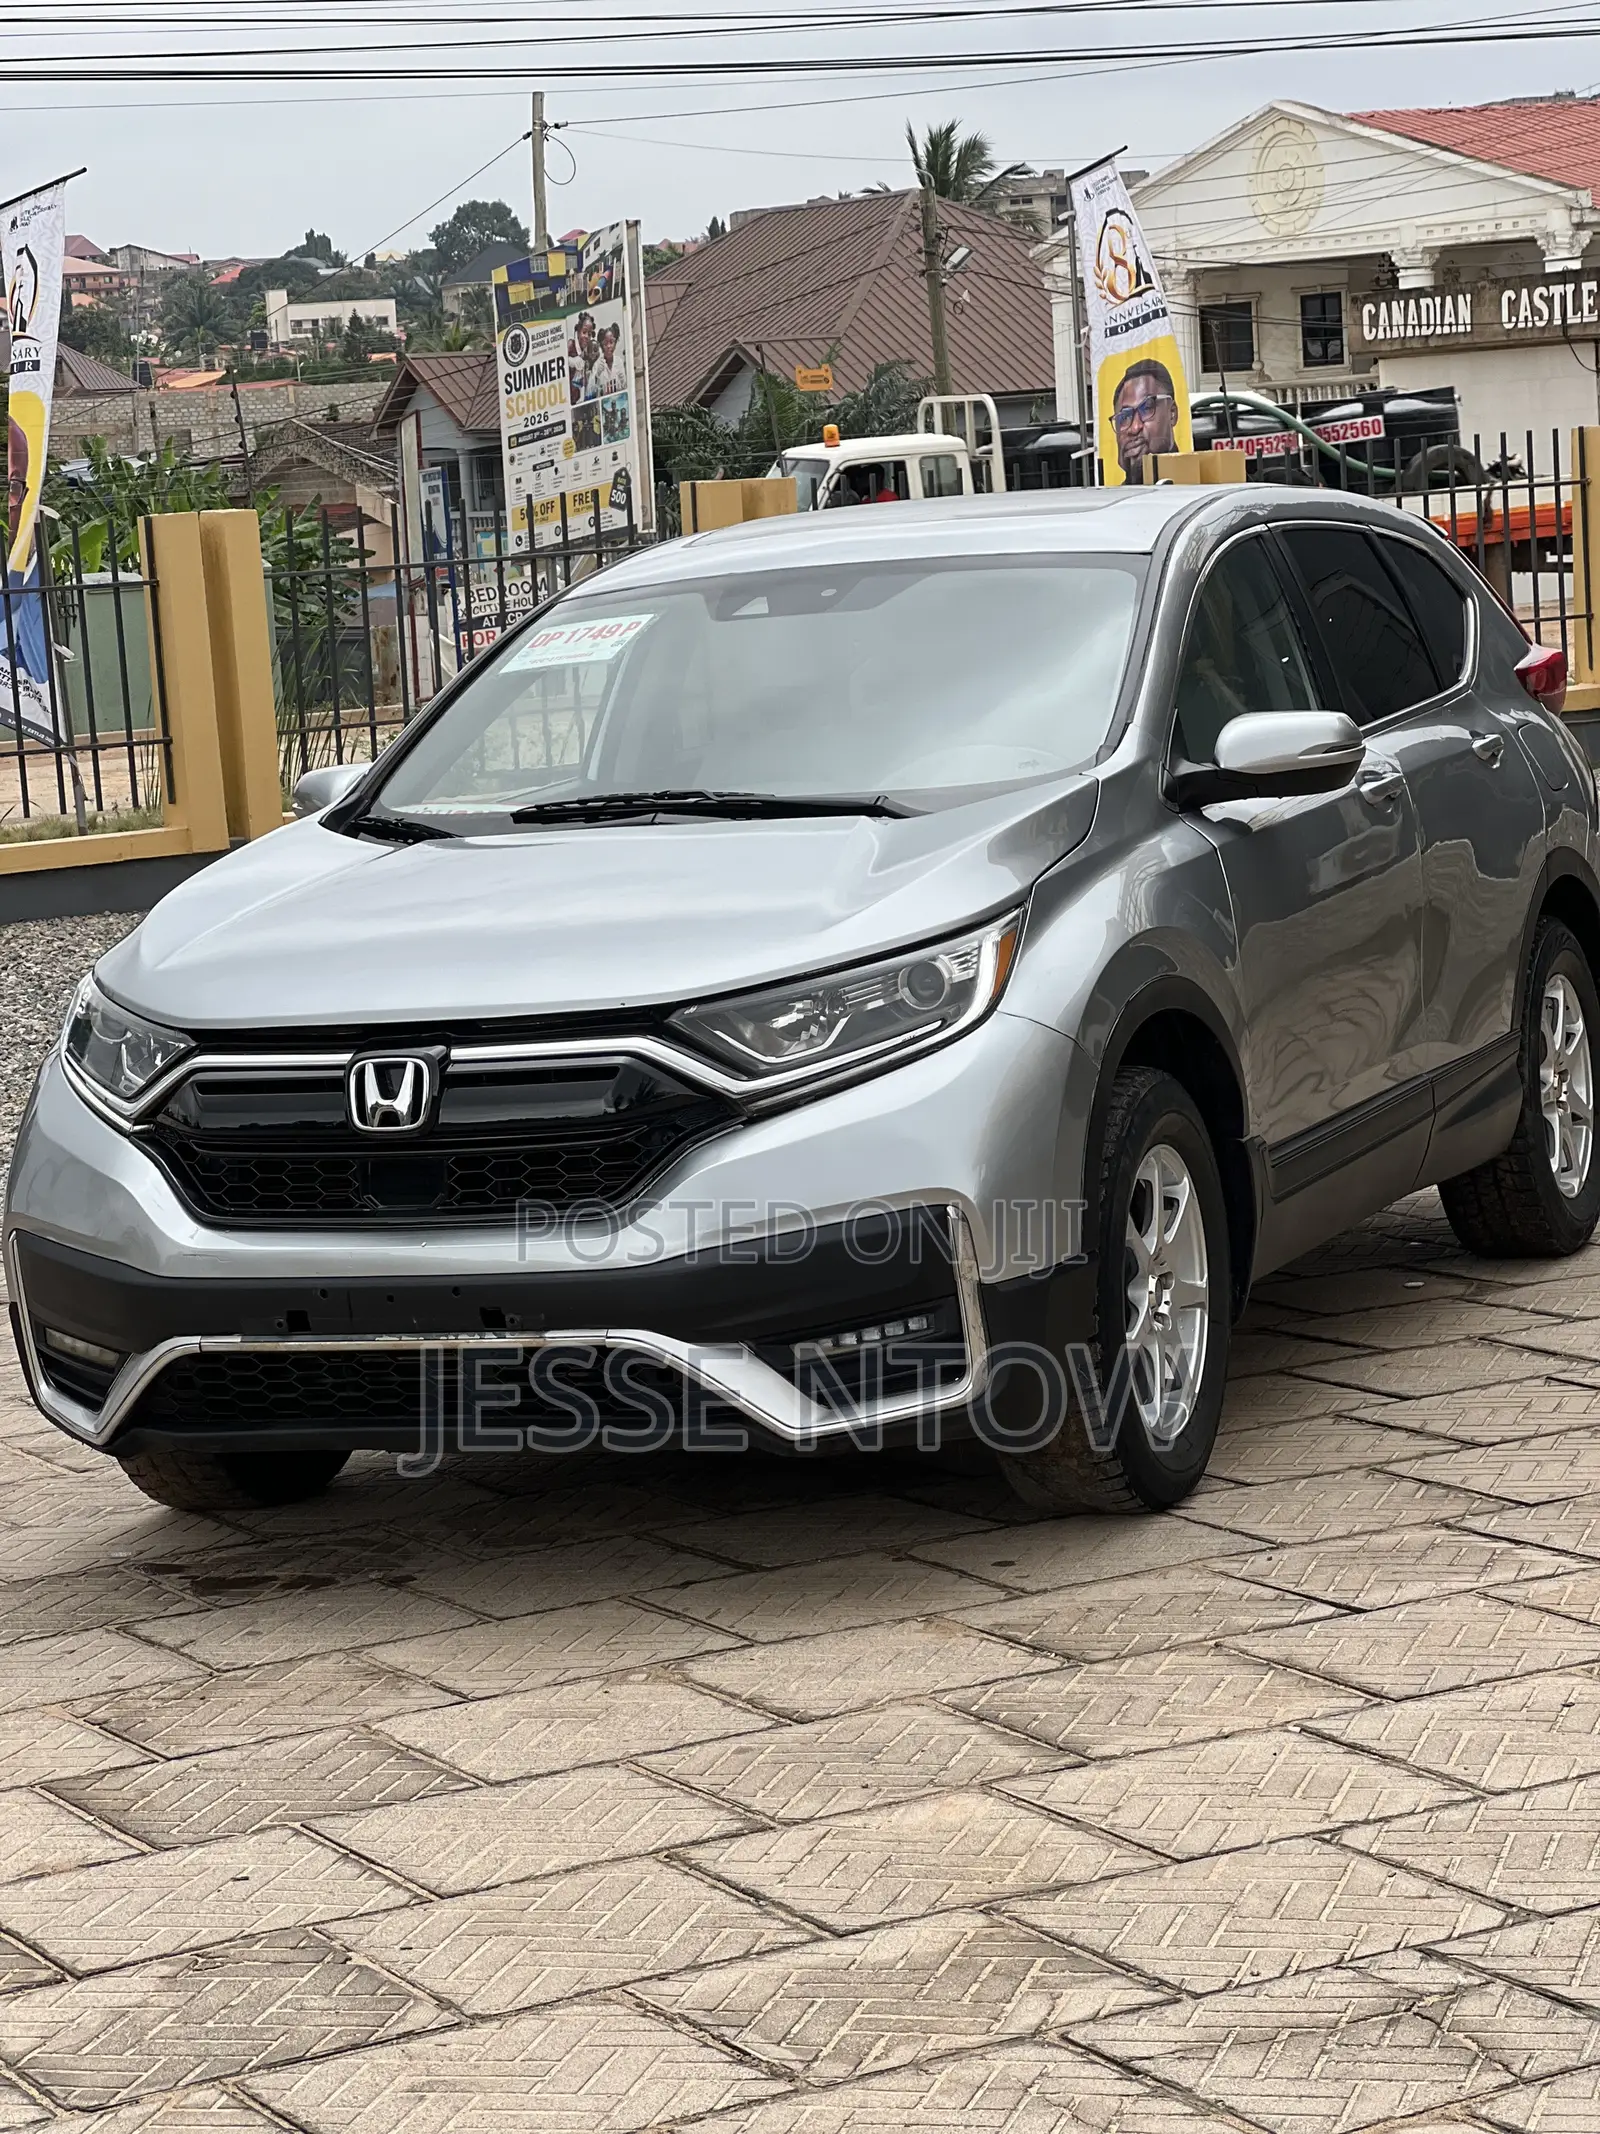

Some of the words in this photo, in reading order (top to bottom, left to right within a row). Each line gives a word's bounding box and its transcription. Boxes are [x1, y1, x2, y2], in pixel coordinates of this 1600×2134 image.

[1362, 293, 1472, 341] CANADIAN
[1500, 280, 1599, 330] CASTLE
[504, 356, 566, 396] SUMMER
[505, 382, 567, 420] SCHOOL
[523, 411, 550, 429] 2026
[610, 489, 627, 505] 500
[520, 504, 538, 521] 5%
[540, 500, 555, 516] OFF
[482, 615, 497, 628] AT
[528, 631, 565, 649] DP
[564, 623, 623, 644] 1749
[618, 620, 642, 637] P
